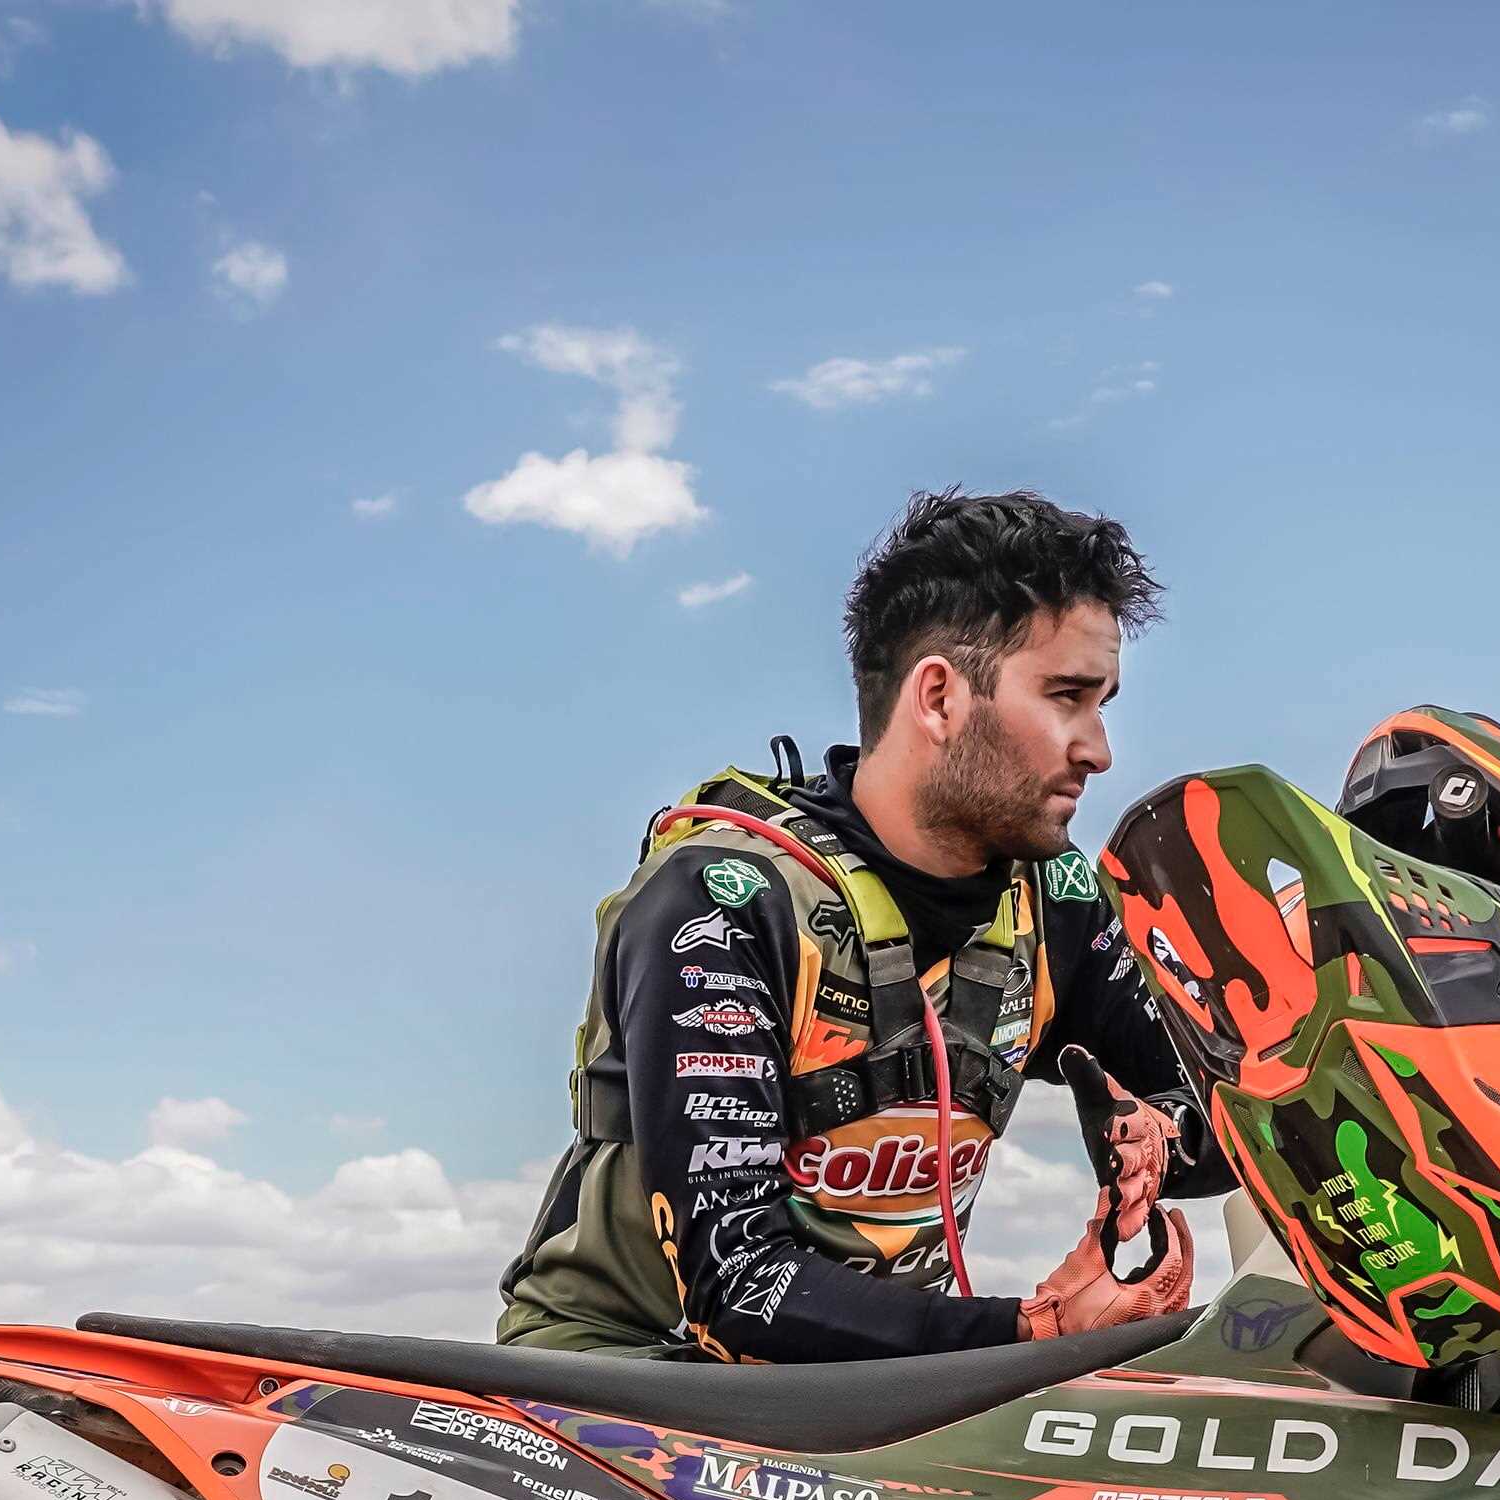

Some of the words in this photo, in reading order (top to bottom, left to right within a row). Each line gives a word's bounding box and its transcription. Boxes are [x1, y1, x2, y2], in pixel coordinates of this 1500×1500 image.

[707, 1013, 752, 1022] PALMAX
[677, 1055, 756, 1073] SPONSER
[690, 1107, 779, 1121] action
[688, 1136, 783, 1173] KTM
[1321, 1170, 1360, 1198] MUCH
[1337, 1196, 1376, 1223] MORE
[1356, 1222, 1392, 1245] THAN
[1365, 1240, 1421, 1269] COCAINE
[449, 1421, 480, 1442] DE
[456, 1408, 559, 1453] GOBIERNO
[1023, 1410, 1340, 1475] GOLD
[763, 1458, 823, 1478] HACIENDA
